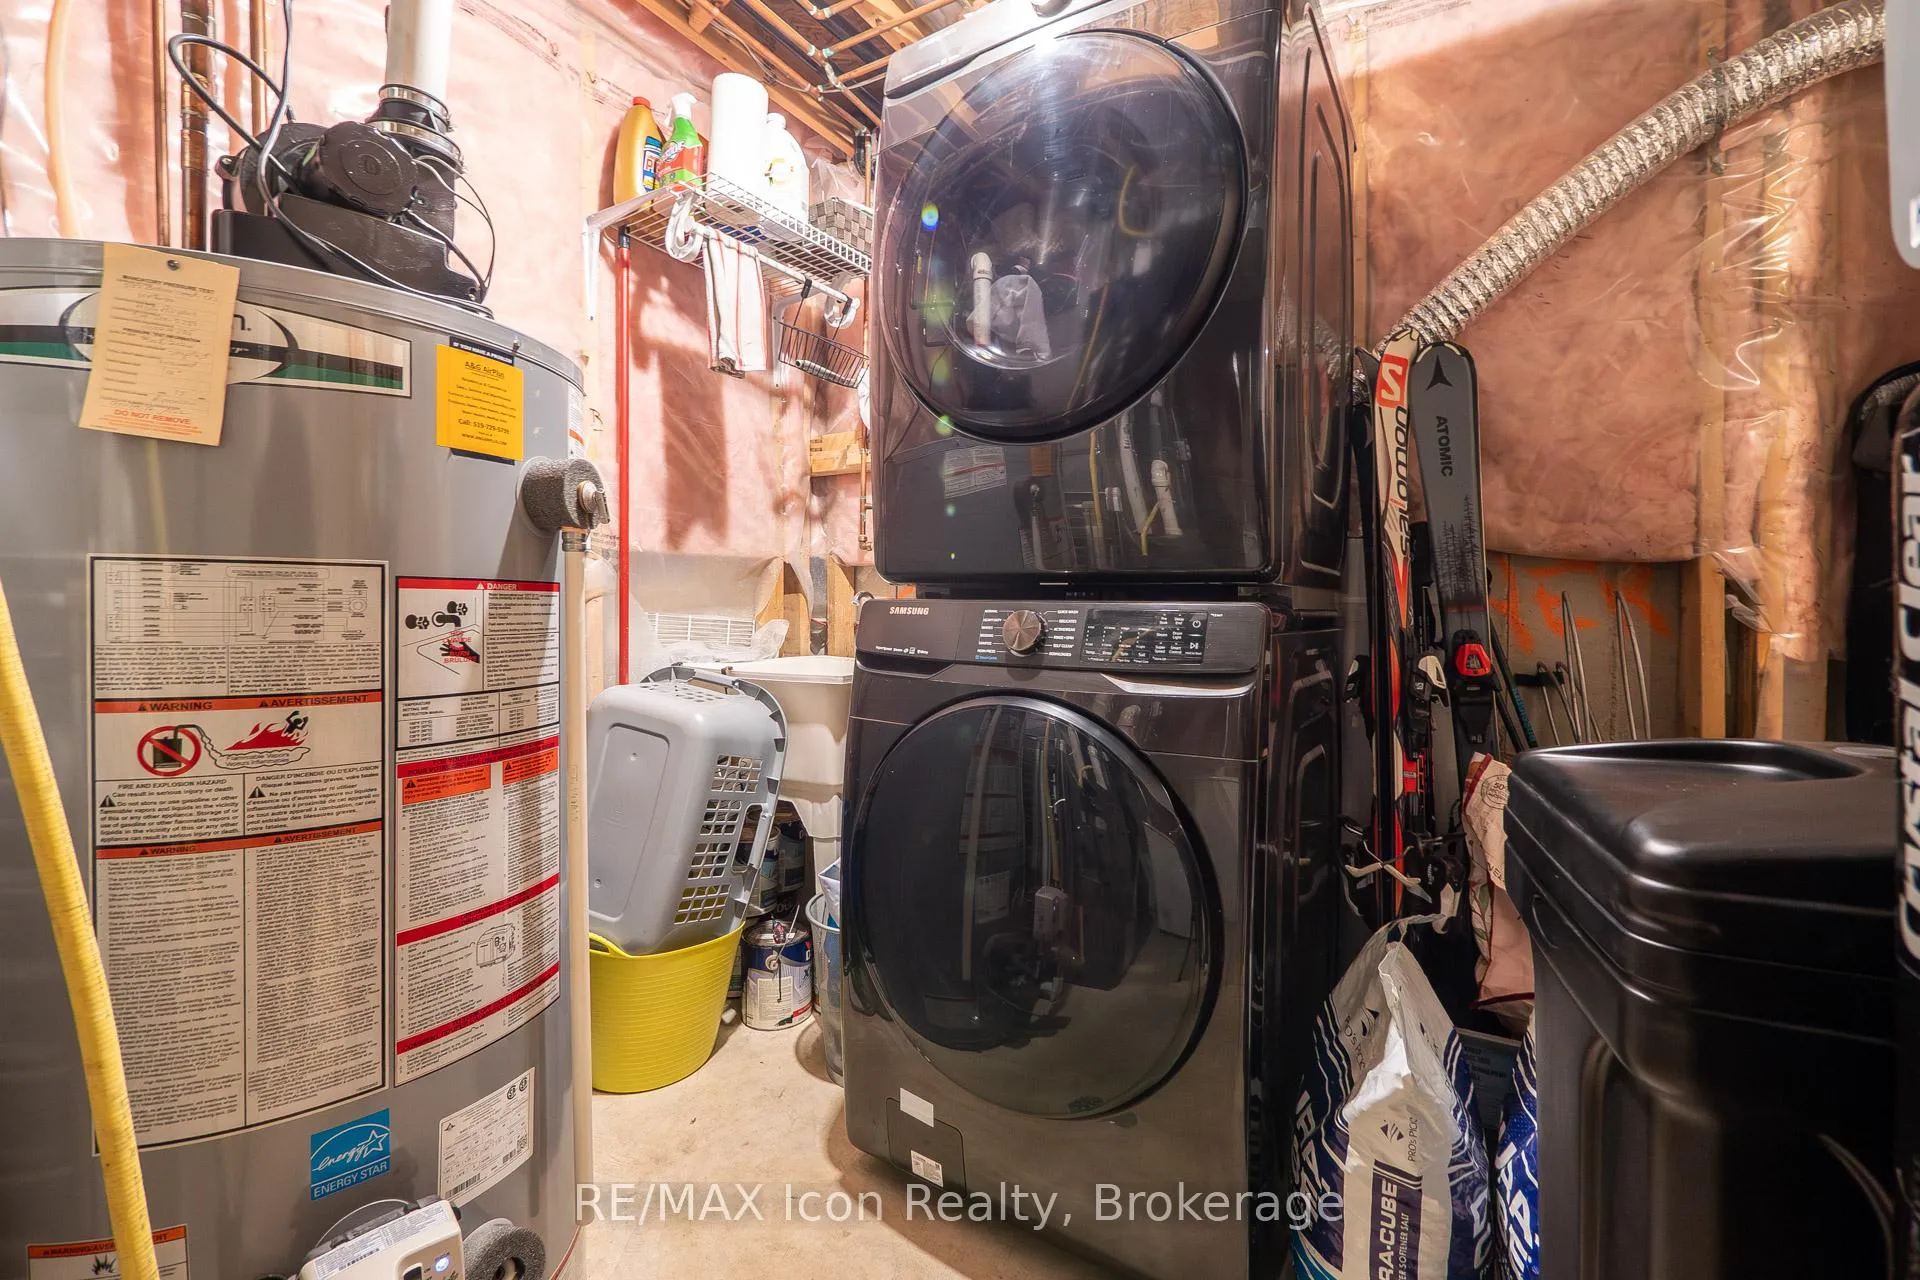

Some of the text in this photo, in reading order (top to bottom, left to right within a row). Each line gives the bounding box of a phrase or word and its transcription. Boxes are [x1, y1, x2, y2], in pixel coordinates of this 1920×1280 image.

[113, 408, 191, 424] DO NOT REMOVE
[1436, 415, 1453, 477] ATOMIC
[487, 583, 518, 591] DANGER
[889, 606, 930, 616] SAMSUNG
[149, 701, 213, 711] WARNING
[271, 694, 369, 708] AVERTISSEMENT
[1493, 782, 1505, 791] 50
[283, 827, 357, 843] AVERTISSEMENT
[150, 845, 197, 855] WARNING
[313, 1160, 387, 1198] ENERGY STAR
